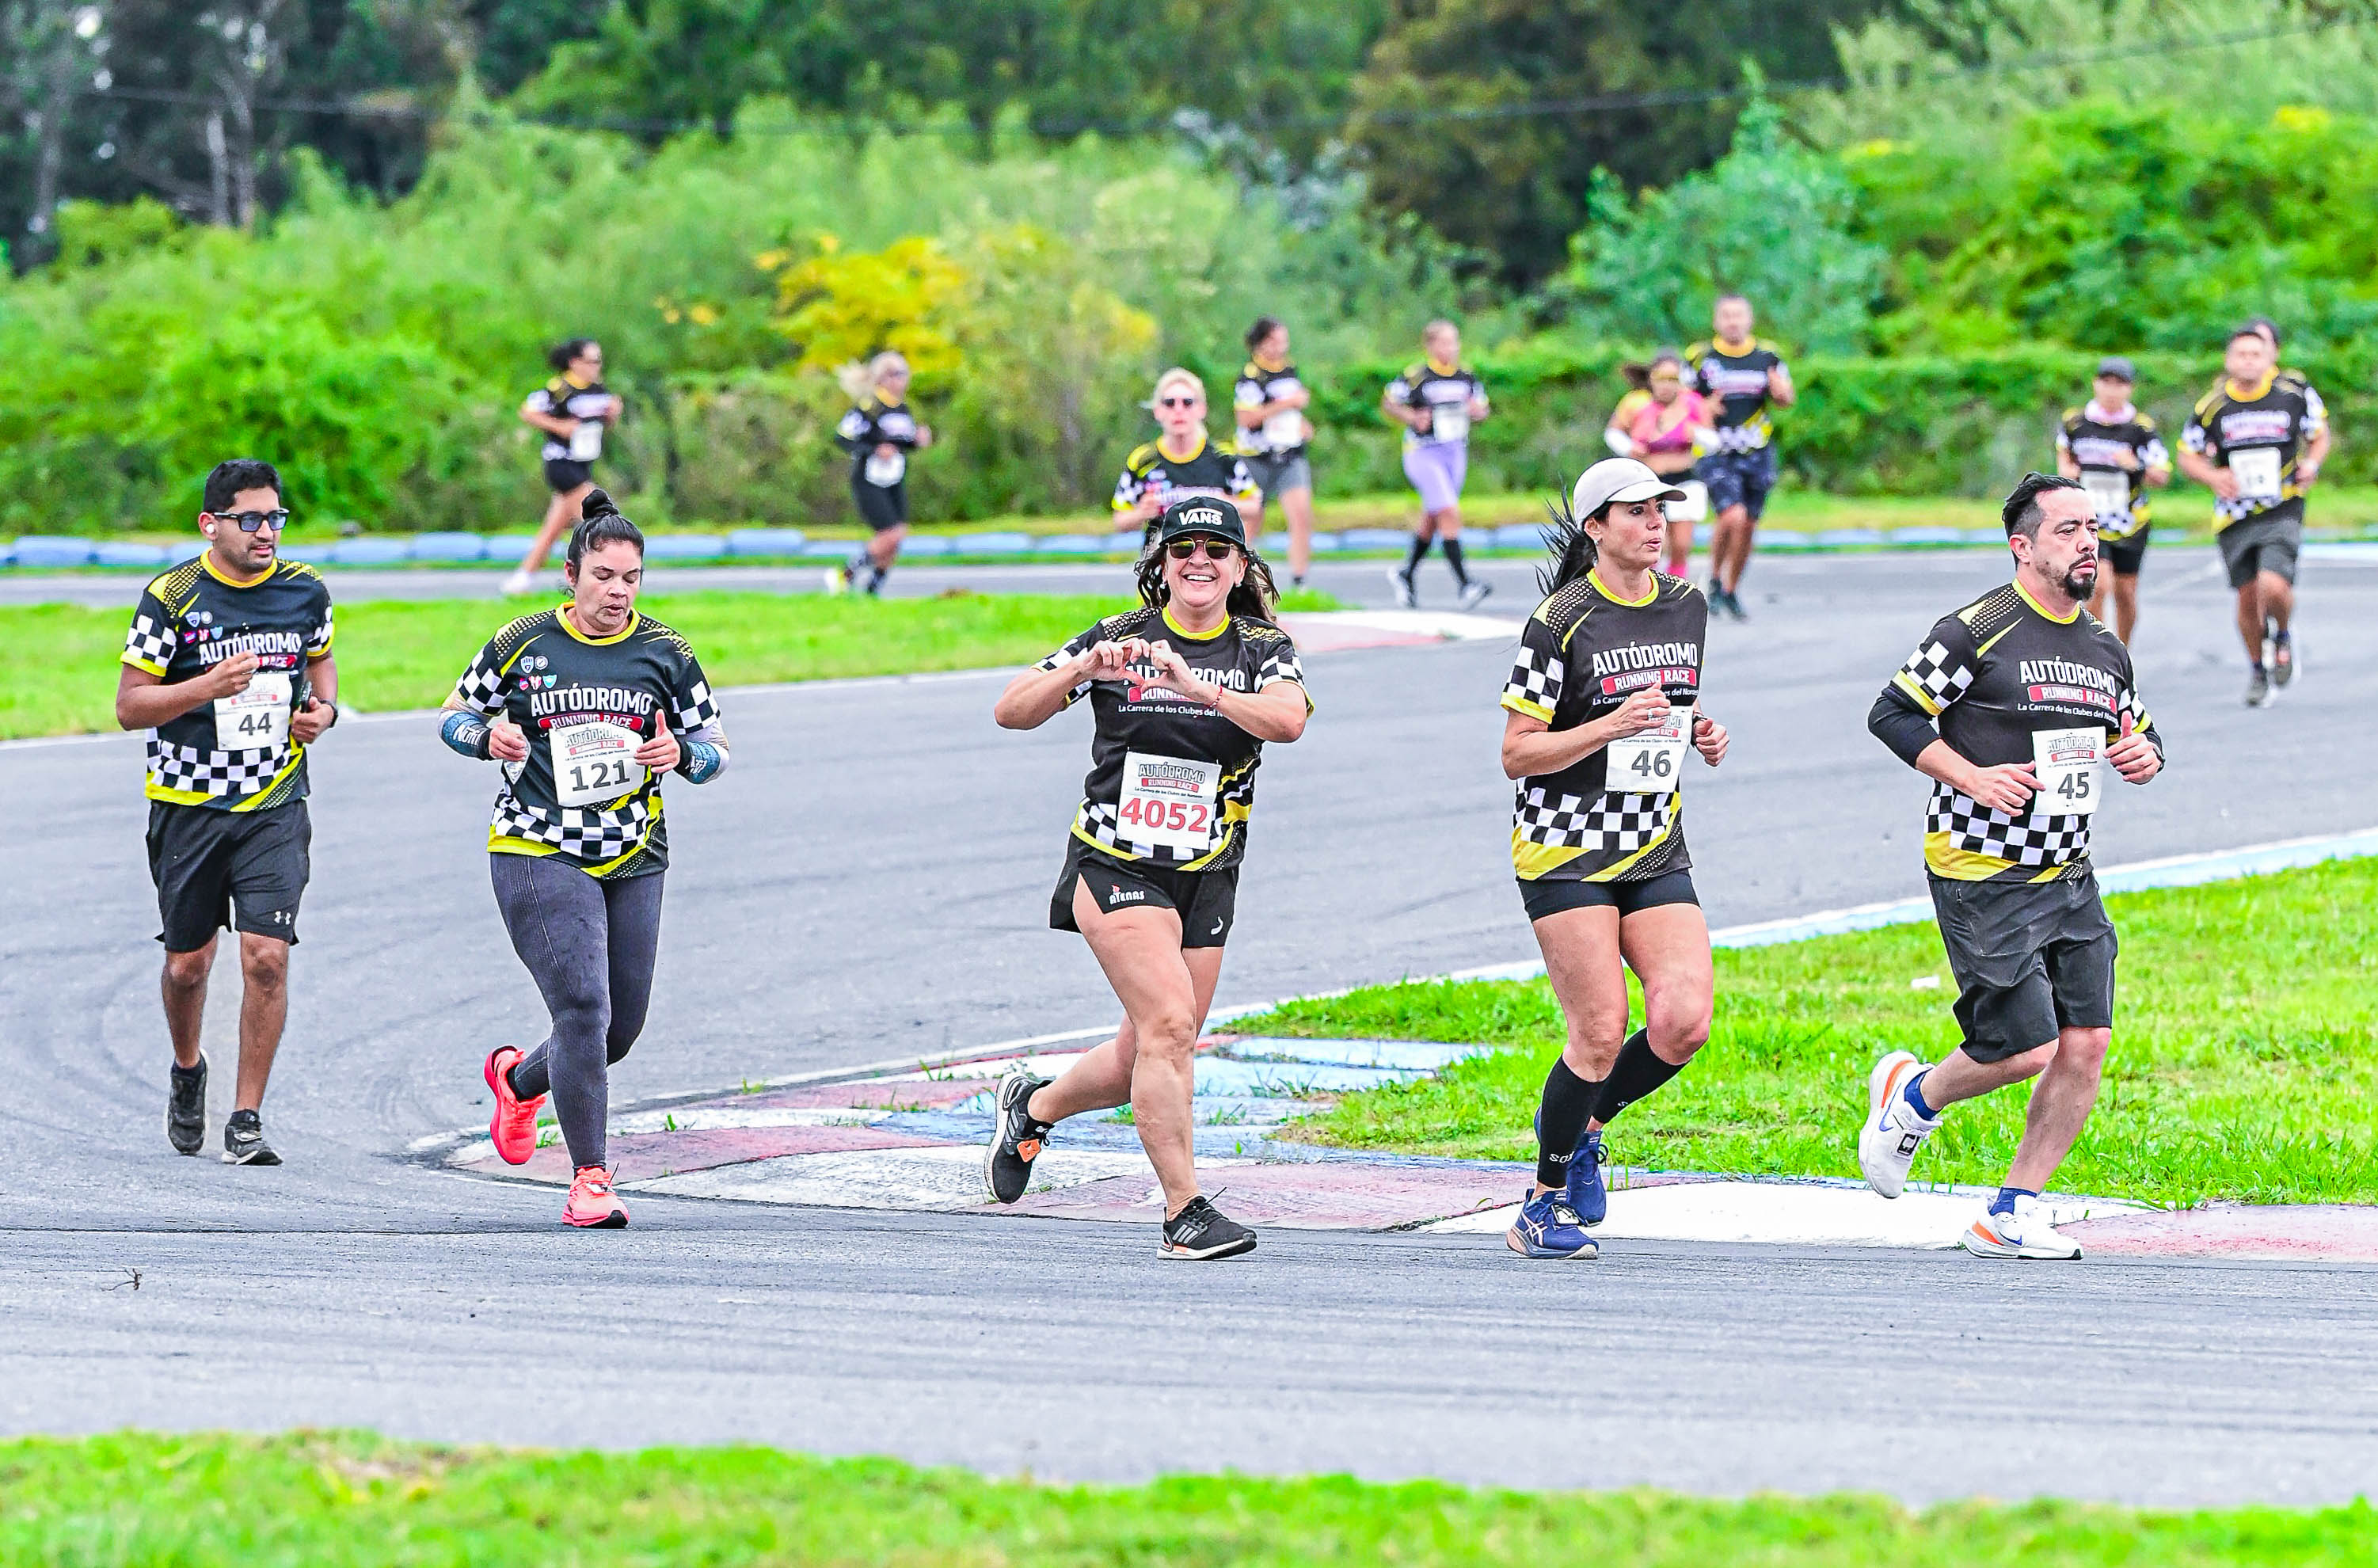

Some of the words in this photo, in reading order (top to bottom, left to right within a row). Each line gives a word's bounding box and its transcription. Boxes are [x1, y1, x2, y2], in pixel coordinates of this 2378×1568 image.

[1178, 508, 1223, 526] VANS
[199, 632, 302, 666] AUTÓDROMO
[1592, 641, 1698, 678] AUTÓDROMO
[1614, 670, 1662, 691] RUNNING
[1664, 669, 1691, 683] RACE
[2019, 655, 2117, 698] AUTÓDROMO
[531, 682, 653, 717] AUTÓDROMO
[1592, 698, 1602, 706] La
[1671, 687, 1683, 696] del
[2041, 687, 2084, 702] RUNNING
[2086, 691, 2111, 710] RACE
[550, 714, 600, 729] RUNNING
[603, 714, 633, 729] RACE
[1127, 704, 1154, 713] Carrera
[1165, 705, 1177, 714] los
[1178, 706, 1204, 716] Clubes
[1204, 708, 1216, 717] del
[2017, 702, 2027, 711] La
[2029, 702, 2055, 712] Carrera
[2055, 704, 2064, 713] de
[2064, 705, 2072, 714] los
[2072, 707, 2093, 717] Clubes
[2093, 710, 2104, 719] del
[238, 712, 272, 736] 44
[1139, 762, 1206, 784] AUTÓDROMO
[1631, 749, 1672, 778] 46
[569, 759, 630, 792] 121
[1177, 781, 1193, 790] RACE
[2057, 771, 2090, 800] 45
[1121, 797, 1208, 833] 4052
